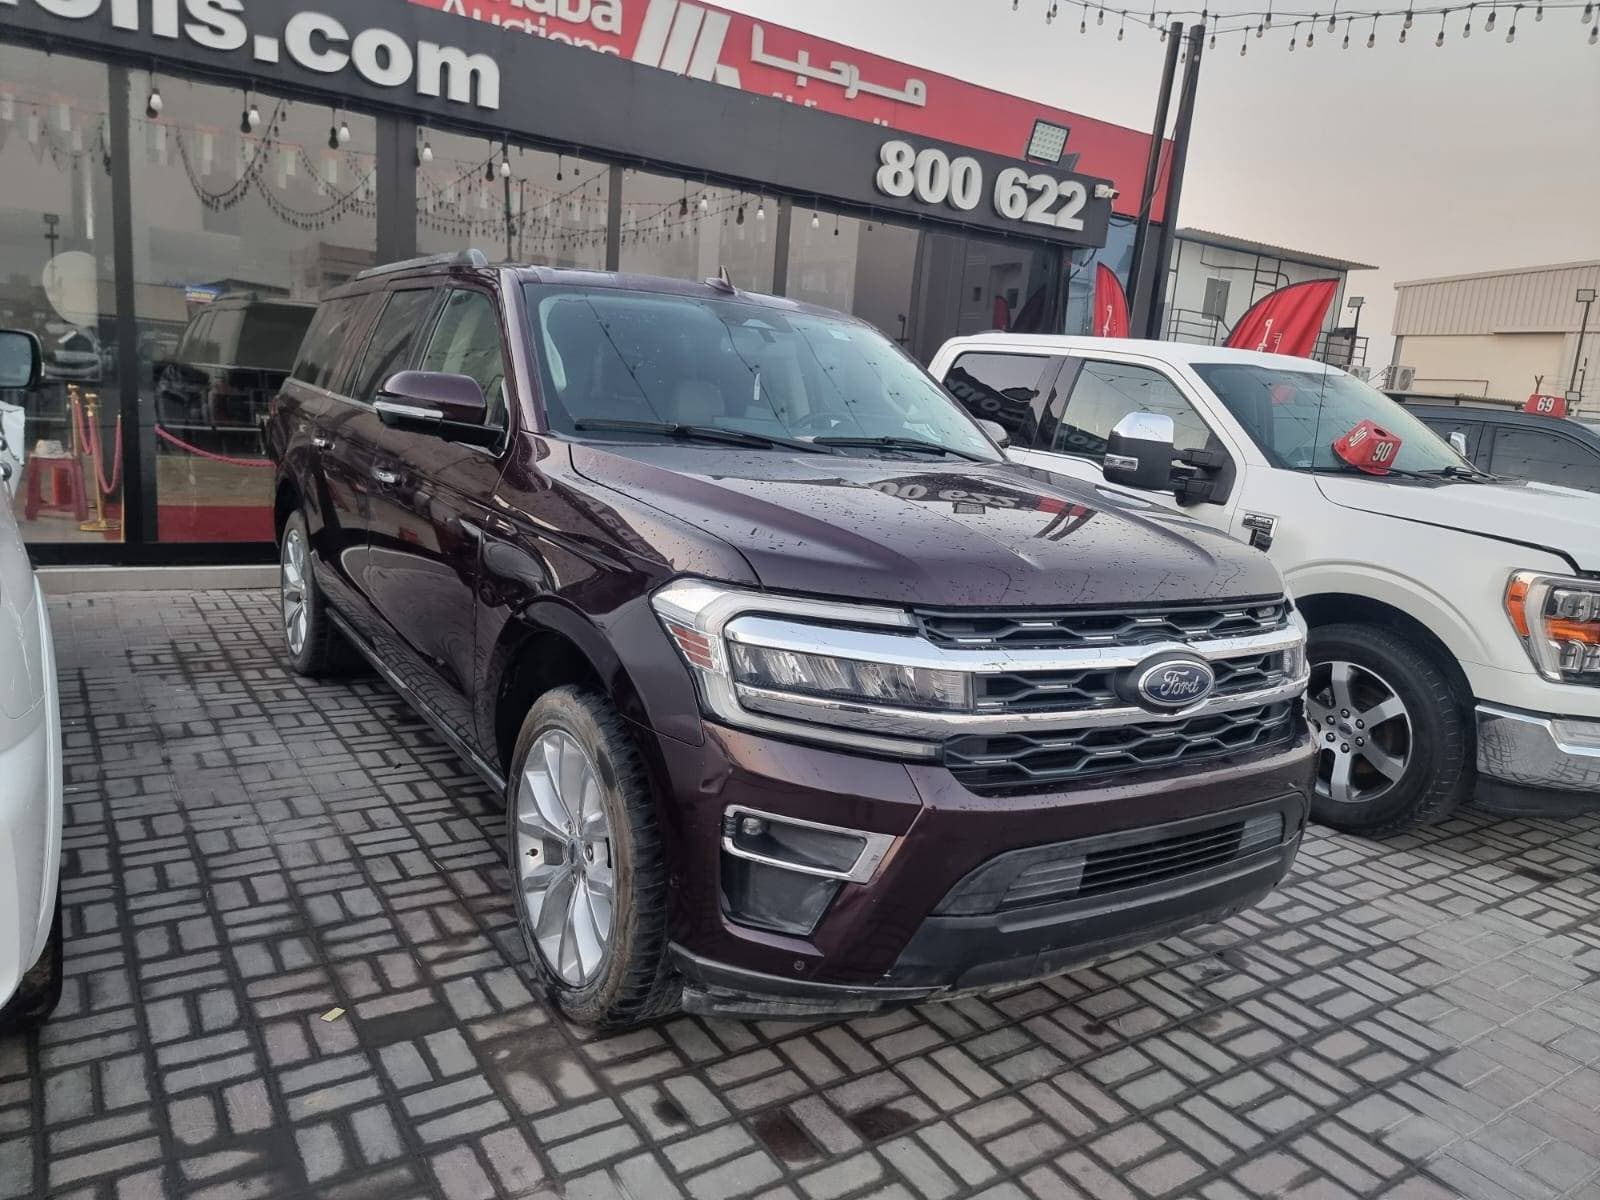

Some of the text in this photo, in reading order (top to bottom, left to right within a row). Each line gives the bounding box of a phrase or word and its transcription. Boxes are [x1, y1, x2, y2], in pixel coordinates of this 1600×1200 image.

[751, 23, 927, 107] مرحبا
[876, 140, 1087, 231] 800 622
[1536, 397, 1555, 413] 69
[1372, 441, 1394, 462] 90
[1160, 670, 1200, 696] Ford
